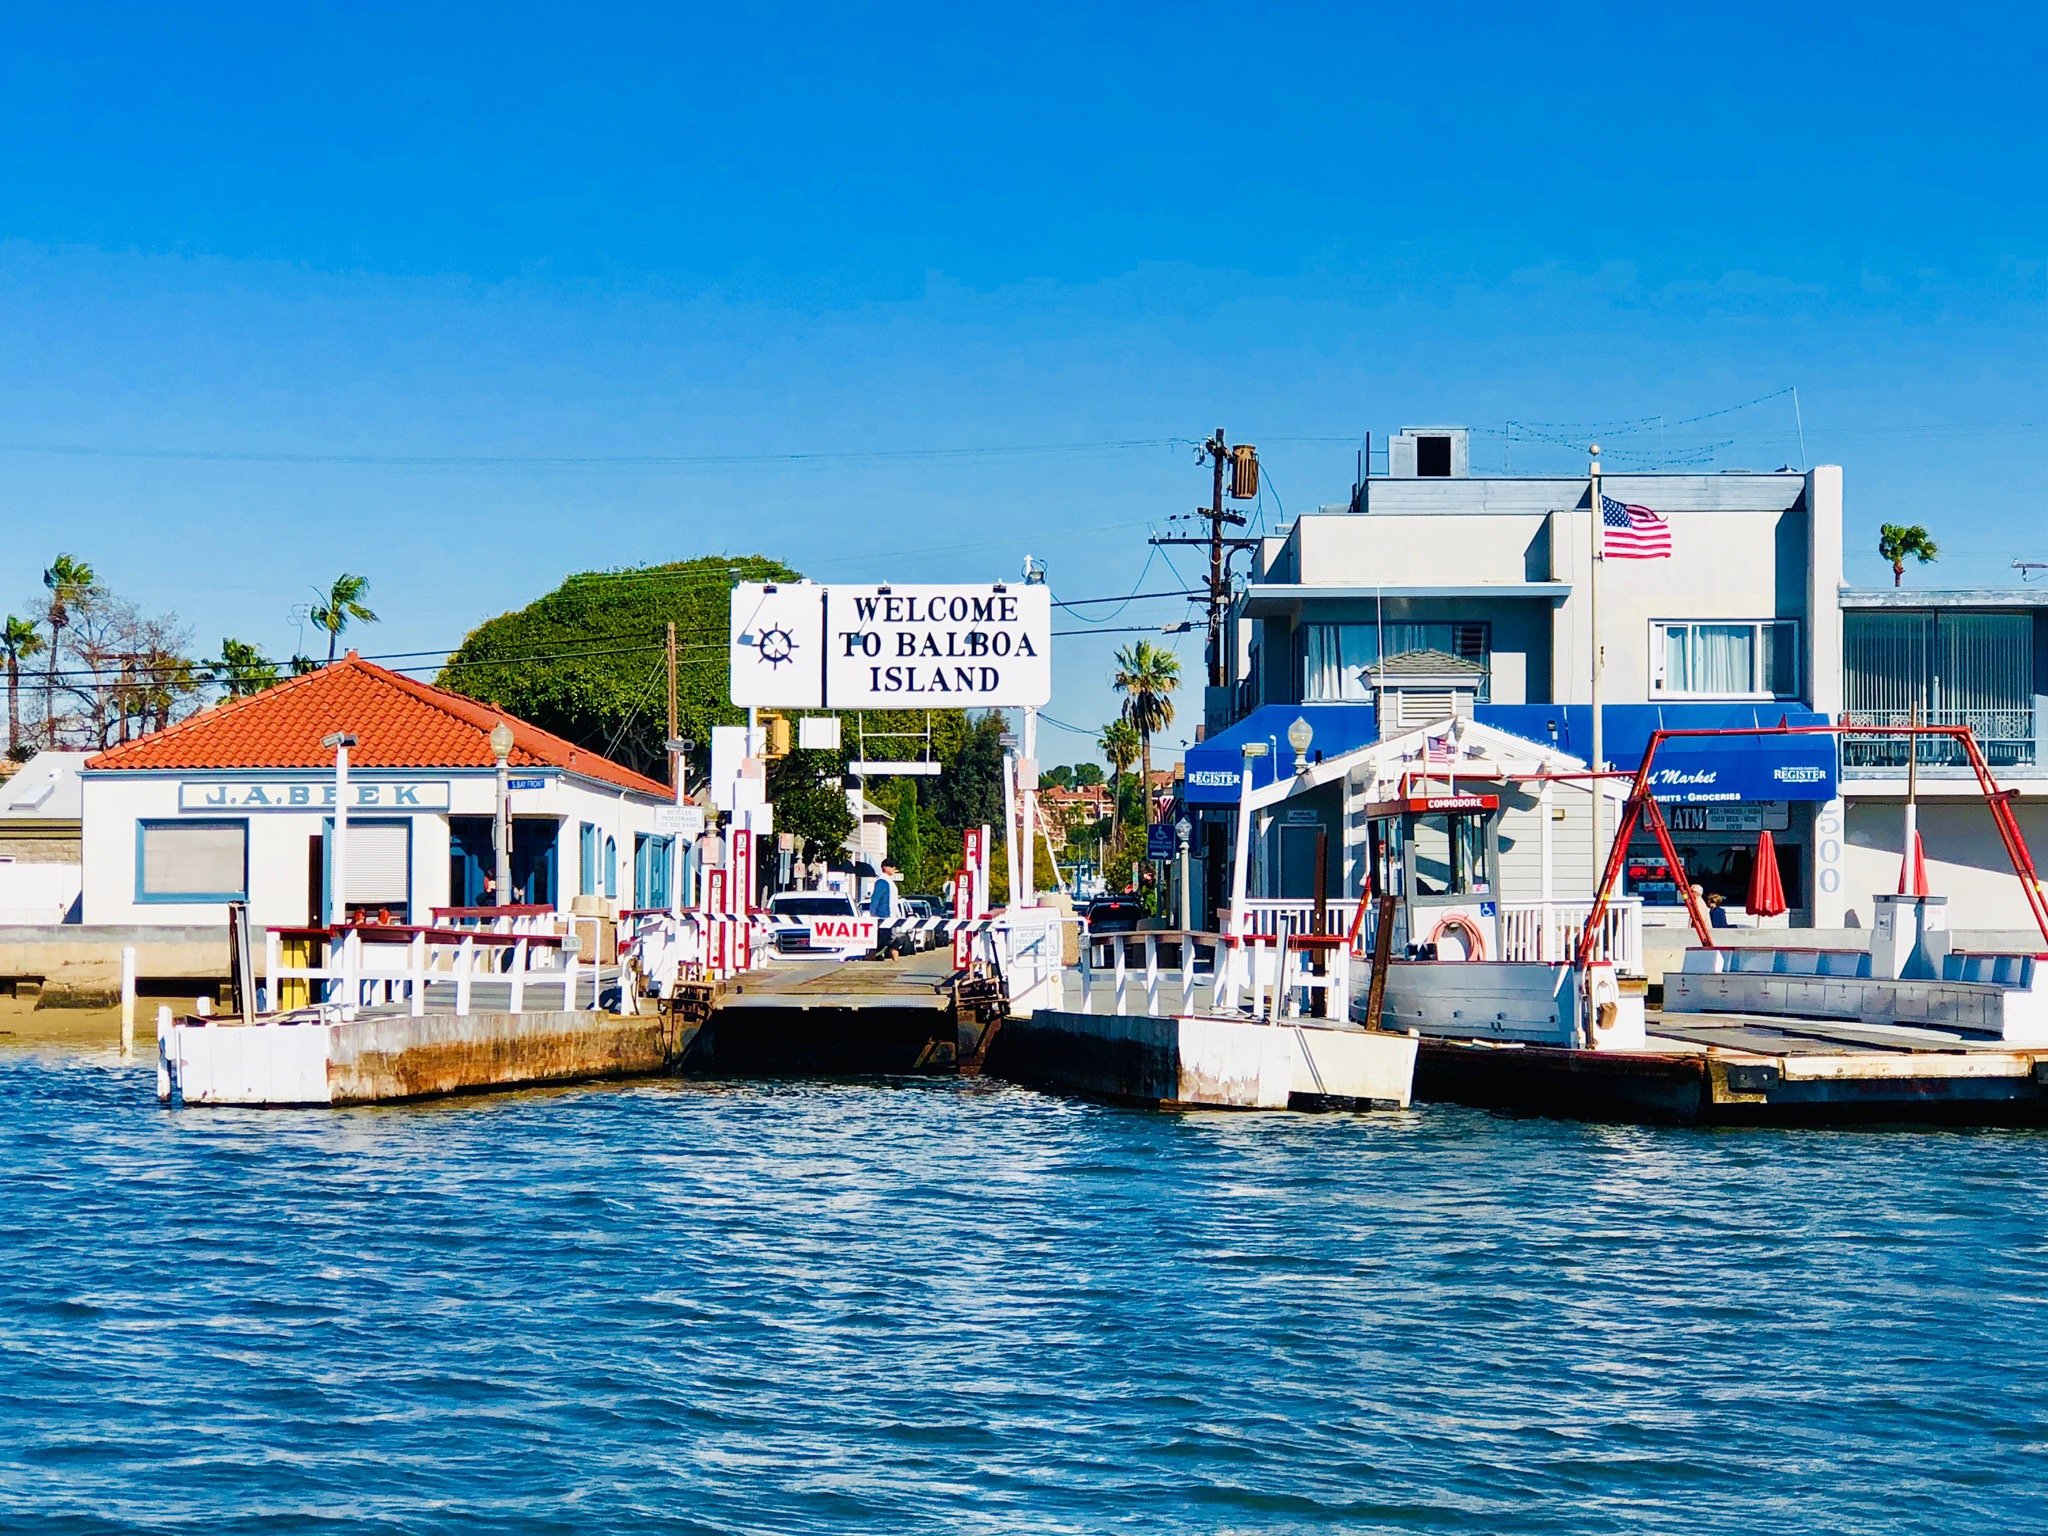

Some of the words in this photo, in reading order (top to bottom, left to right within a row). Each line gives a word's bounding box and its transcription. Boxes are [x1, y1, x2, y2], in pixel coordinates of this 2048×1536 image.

[853, 596, 1018, 622] WELCOME
[838, 632, 882, 657] TO
[896, 631, 1038, 657] BALBOA
[869, 666, 1000, 692] ISLAND
[1188, 773, 1240, 784] REGISTER
[1662, 770, 1716, 785] Market
[1773, 769, 1826, 780] REGISTER
[527, 779, 544, 788] FRONT
[1428, 798, 1483, 809] COMMODORE
[1652, 795, 1681, 803] PIRITS
[1673, 808, 1703, 829] ATM
[814, 922, 873, 938] WAIT
